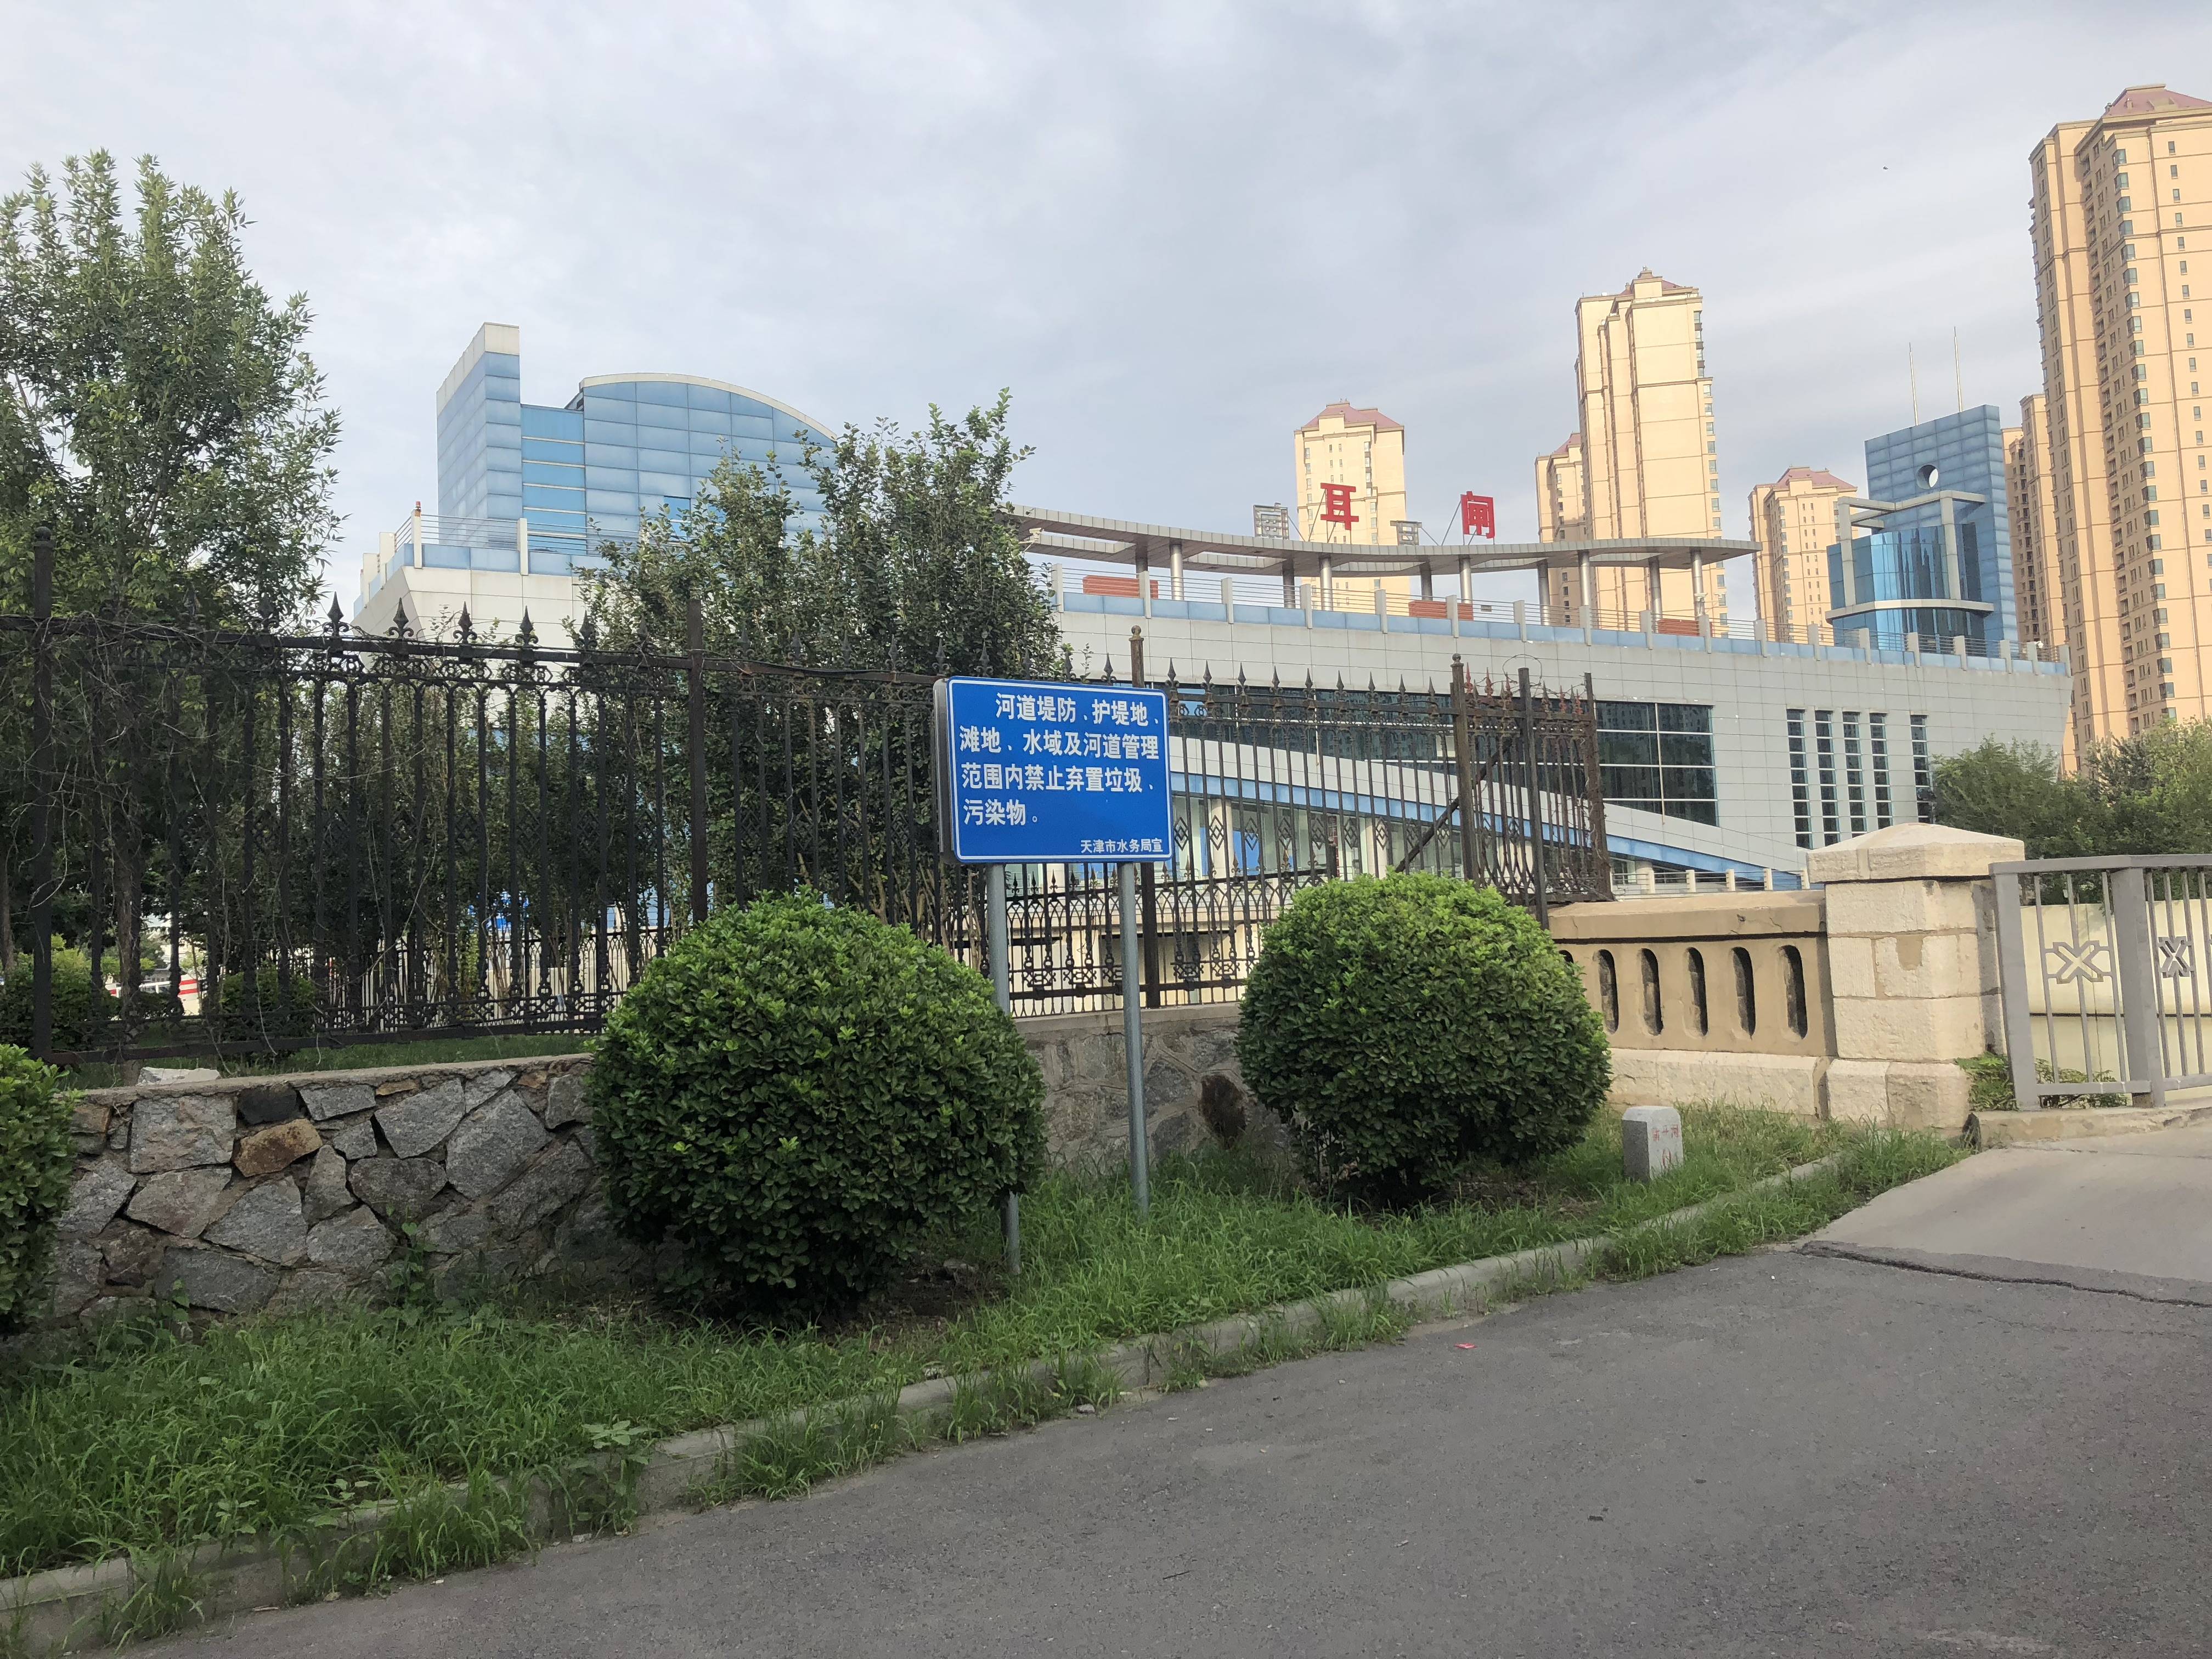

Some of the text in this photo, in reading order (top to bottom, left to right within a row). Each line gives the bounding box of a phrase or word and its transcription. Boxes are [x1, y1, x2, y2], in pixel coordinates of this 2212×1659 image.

[995, 692, 1159, 726] 河道堤防、护堤地、
[959, 725, 1159, 759] 滩地、水域及河道管理
[961, 762, 1154, 793] 范围内禁止弃置垃圾、
[963, 798, 1038, 825] 污染物。
[1080, 838, 1163, 854] 天津市水务局宣
